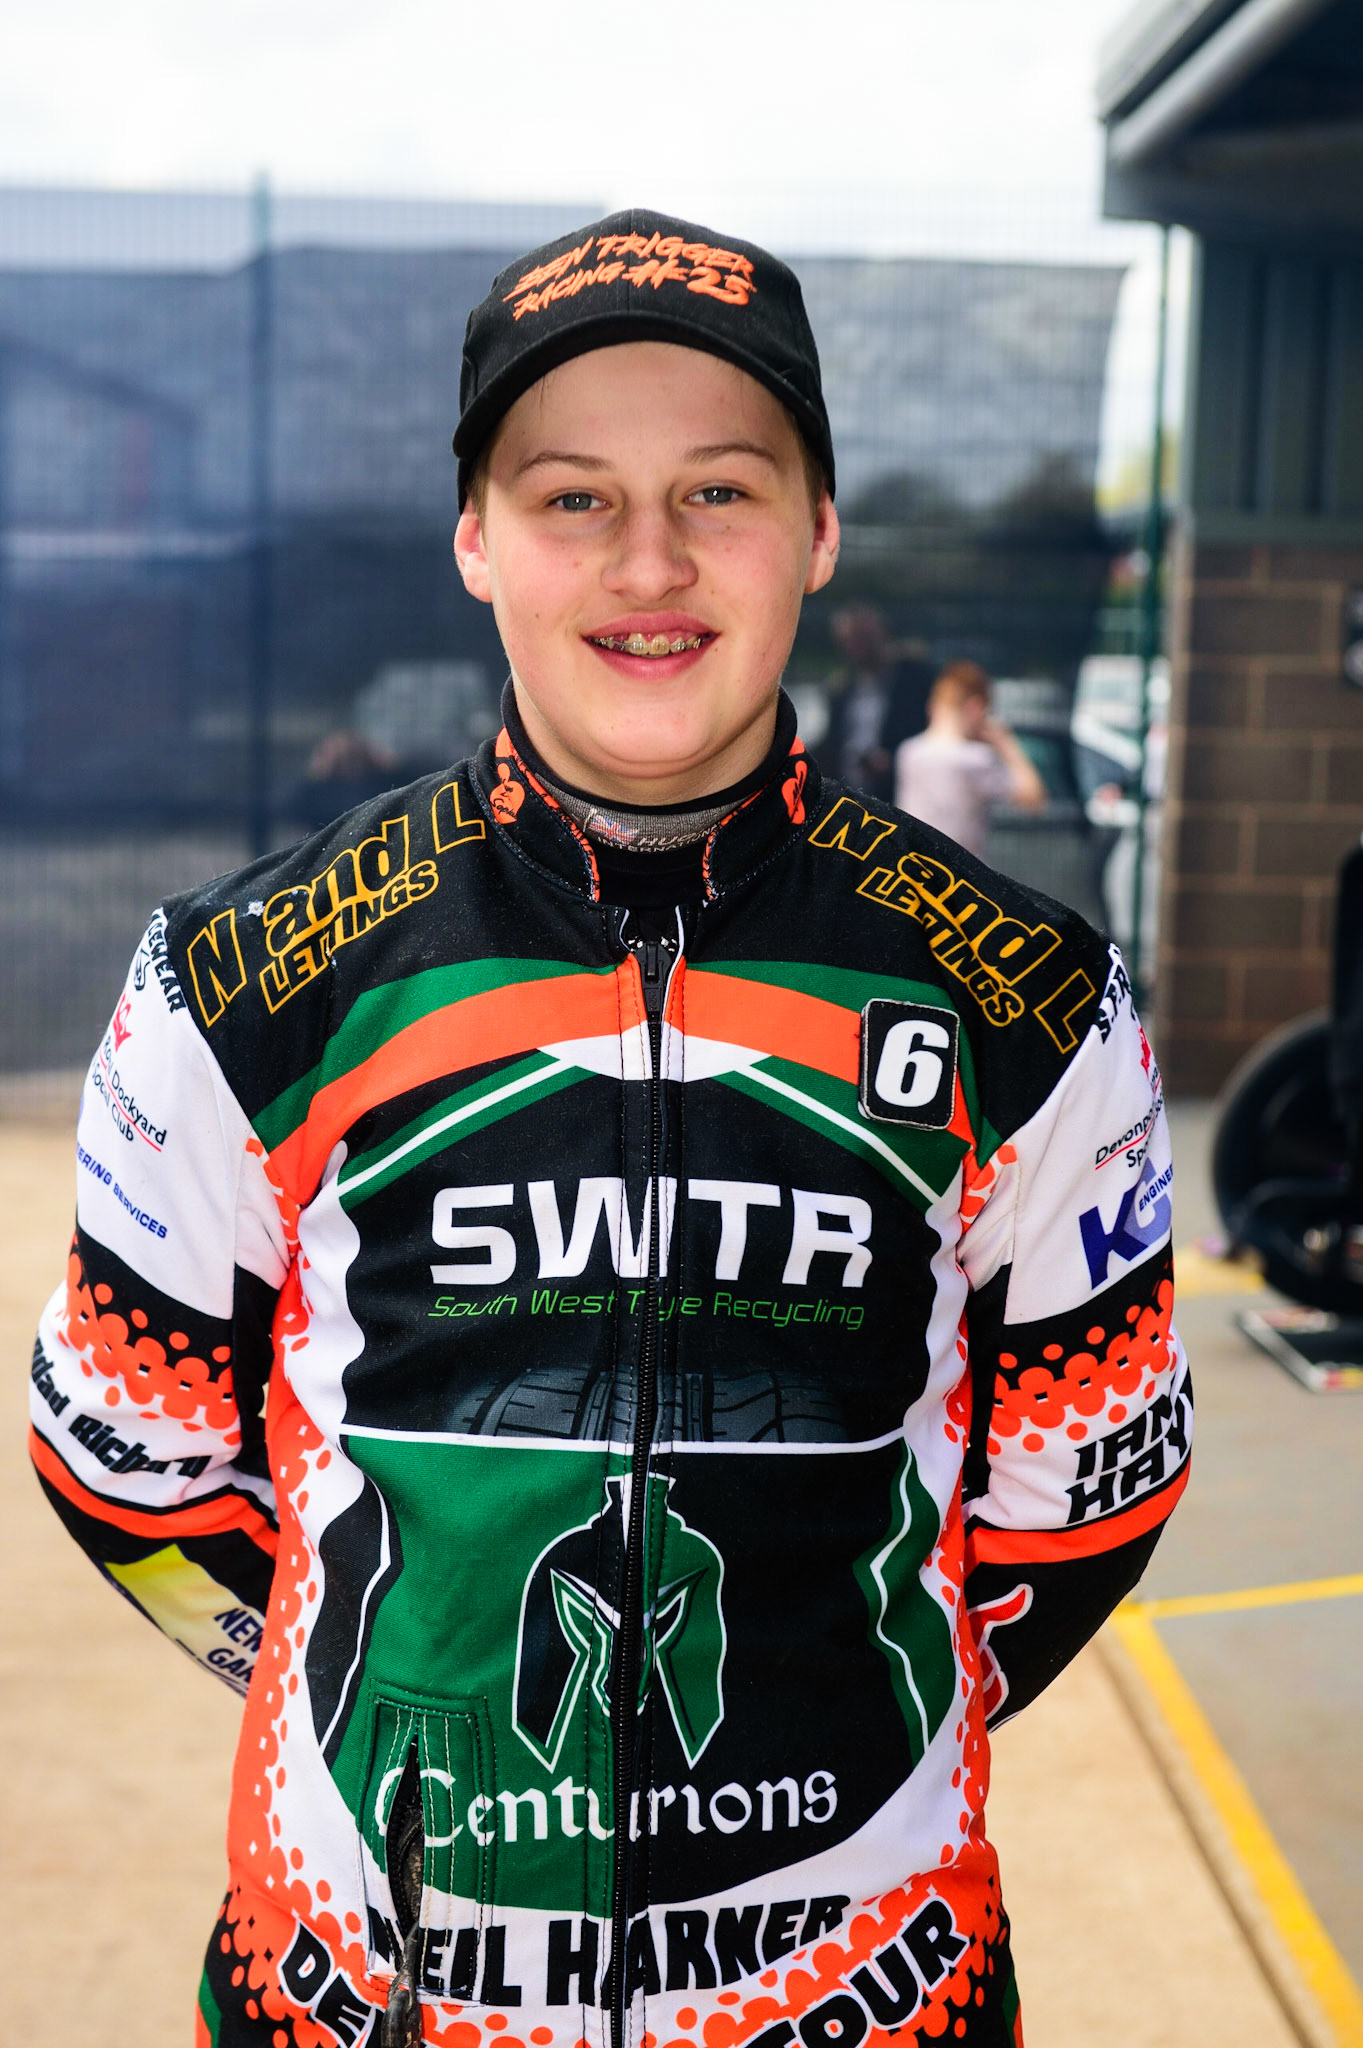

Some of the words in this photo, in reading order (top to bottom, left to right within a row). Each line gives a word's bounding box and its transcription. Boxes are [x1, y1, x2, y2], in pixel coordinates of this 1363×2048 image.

[502, 236, 594, 302] BEN
[596, 231, 758, 293] TRIGGER
[512, 261, 627, 321] RACING
[187, 907, 247, 1028] N
[262, 814, 409, 957] and
[432, 781, 486, 855] L
[807, 797, 898, 861] N
[897, 851, 1063, 987] and
[1032, 967, 1096, 1055] L
[874, 1019, 950, 1108] 6
[111, 1069, 167, 1146] Dockyard
[113, 1182, 168, 1239] SERVICES
[430, 1177, 873, 1288] SWTR
[428, 1294, 518, 1318] South
[531, 1289, 616, 1315] West
[713, 1292, 865, 1331] Recycling
[375, 1770, 838, 1848] Centurions
